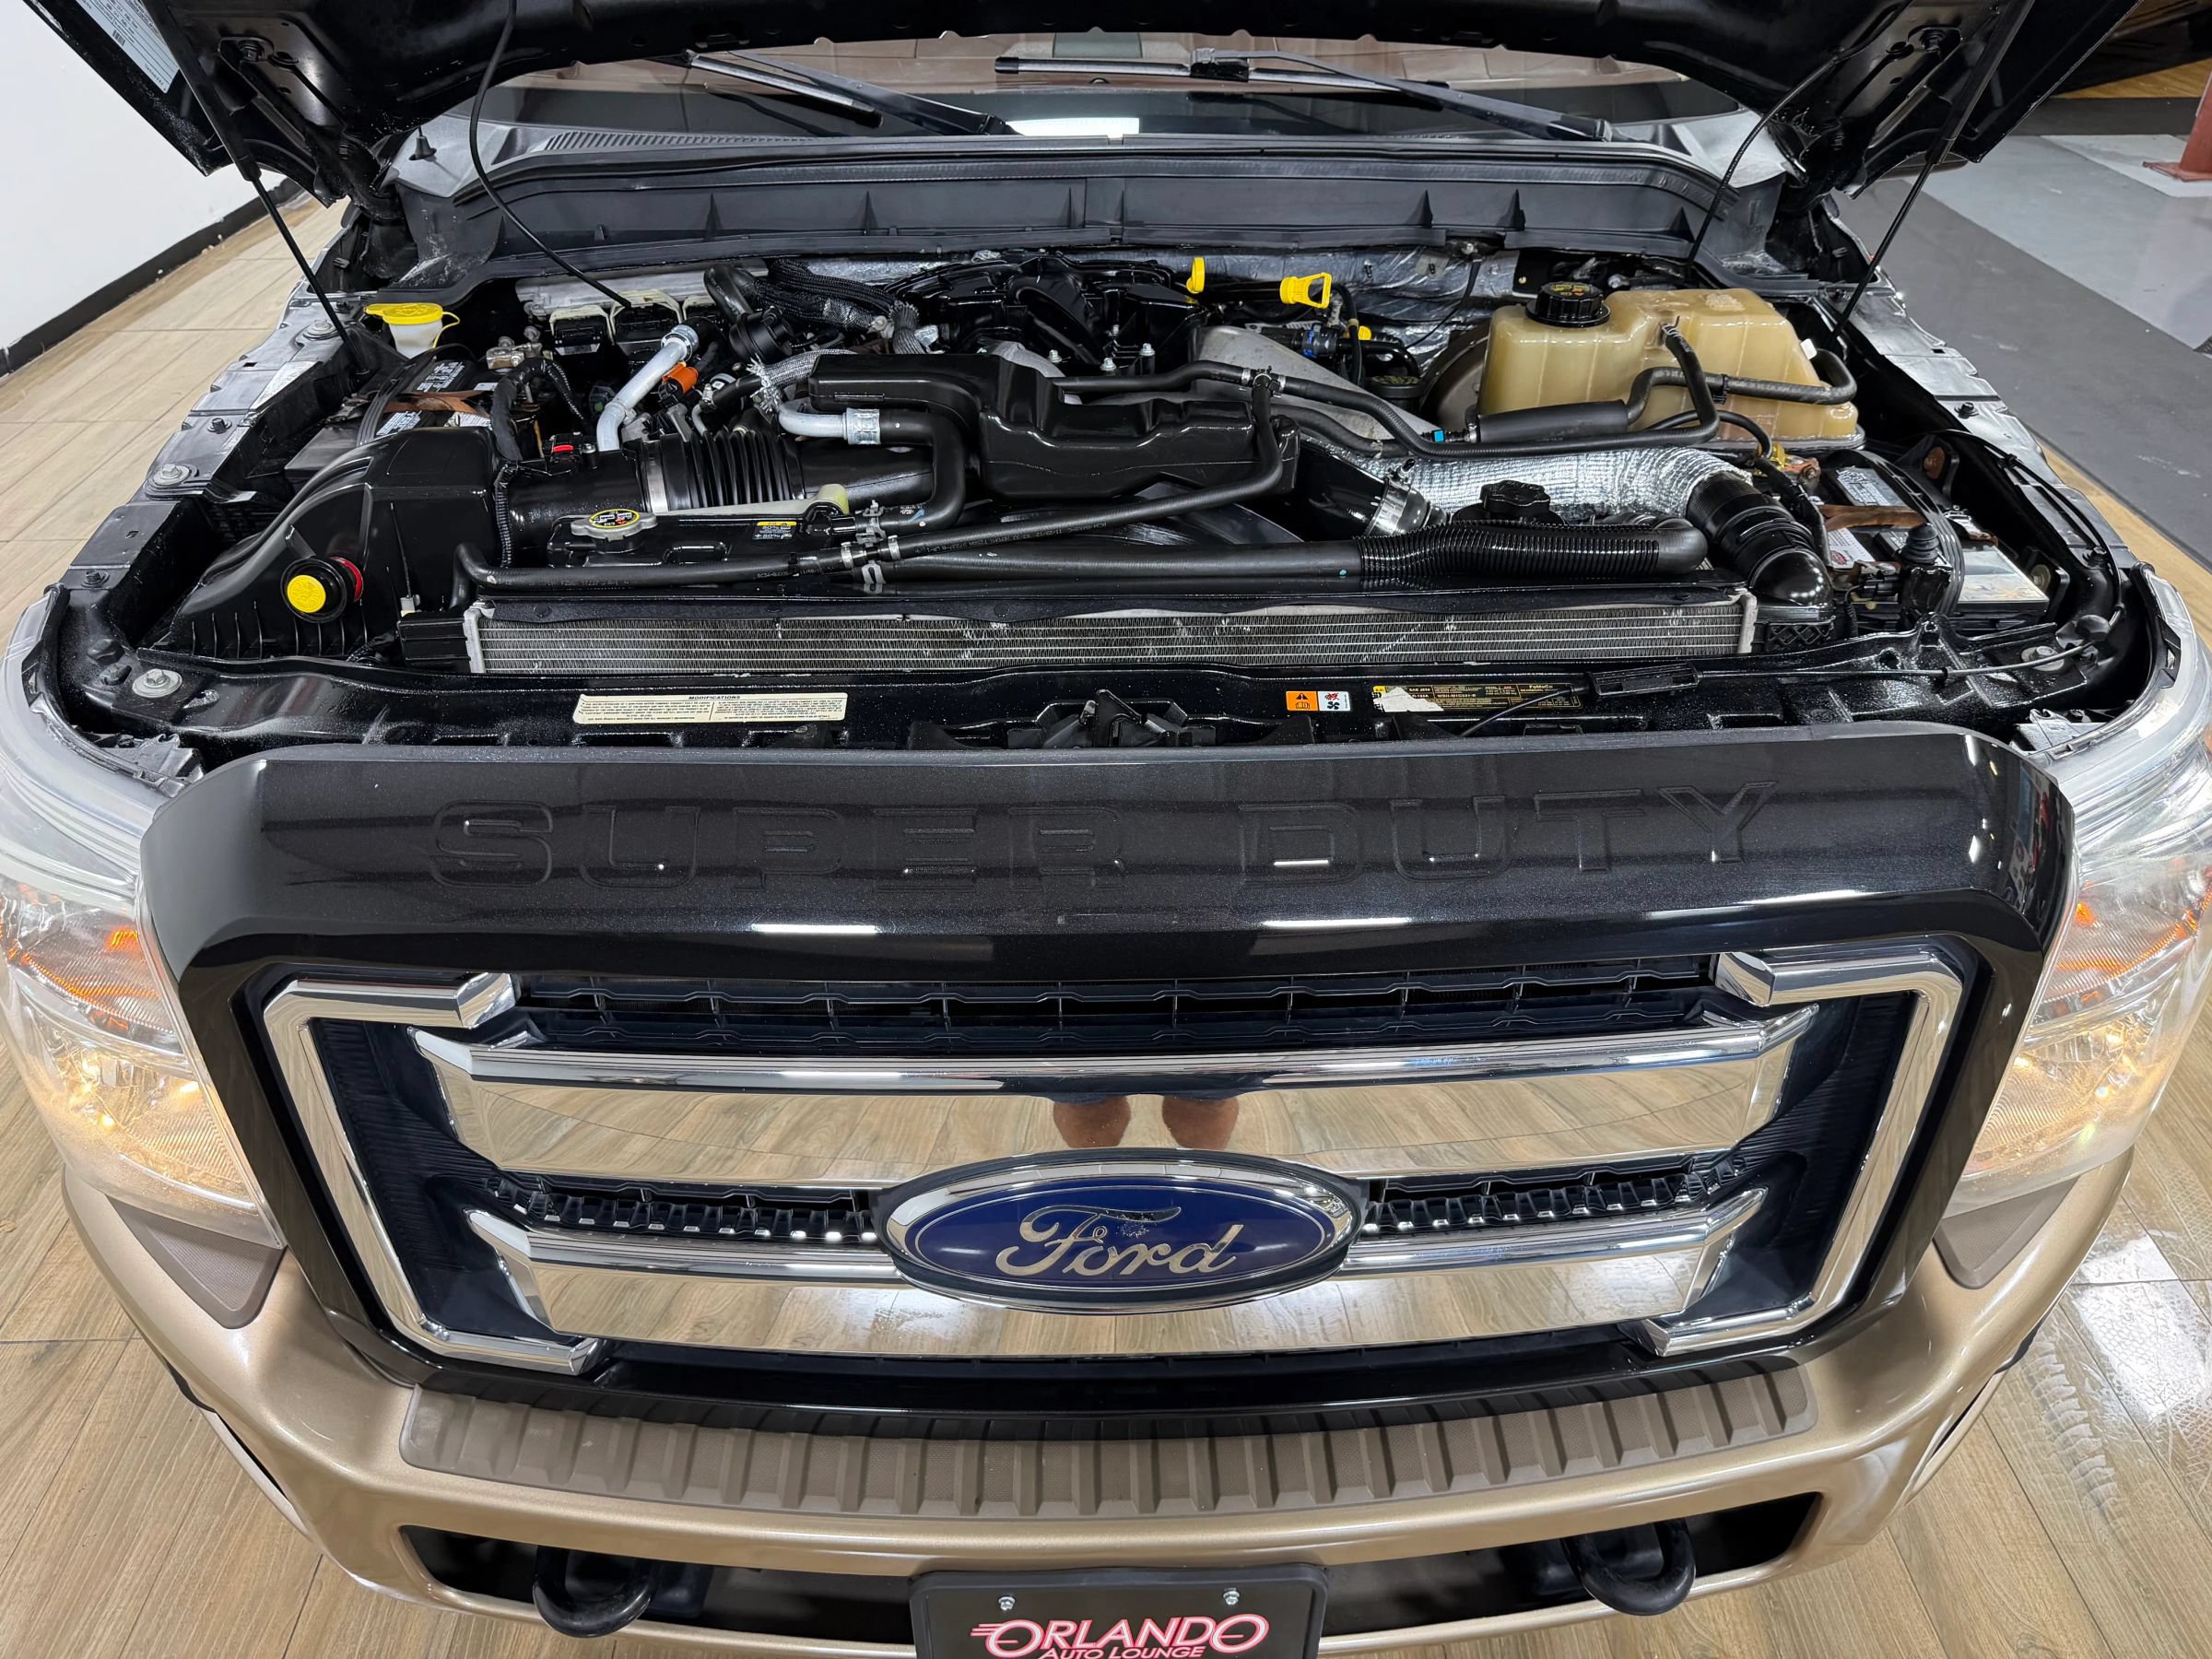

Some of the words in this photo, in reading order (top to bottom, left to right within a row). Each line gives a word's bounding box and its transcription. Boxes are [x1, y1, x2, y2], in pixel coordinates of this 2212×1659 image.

[430, 799, 1126, 893] SUPER
[1239, 780, 1779, 887] DUTY
[995, 1204, 1244, 1277] Ford
[977, 1613, 1270, 1658] ORLANDO
[1038, 1647, 1104, 1659] AUTO
[1109, 1646, 1206, 1659] LOUNGE
